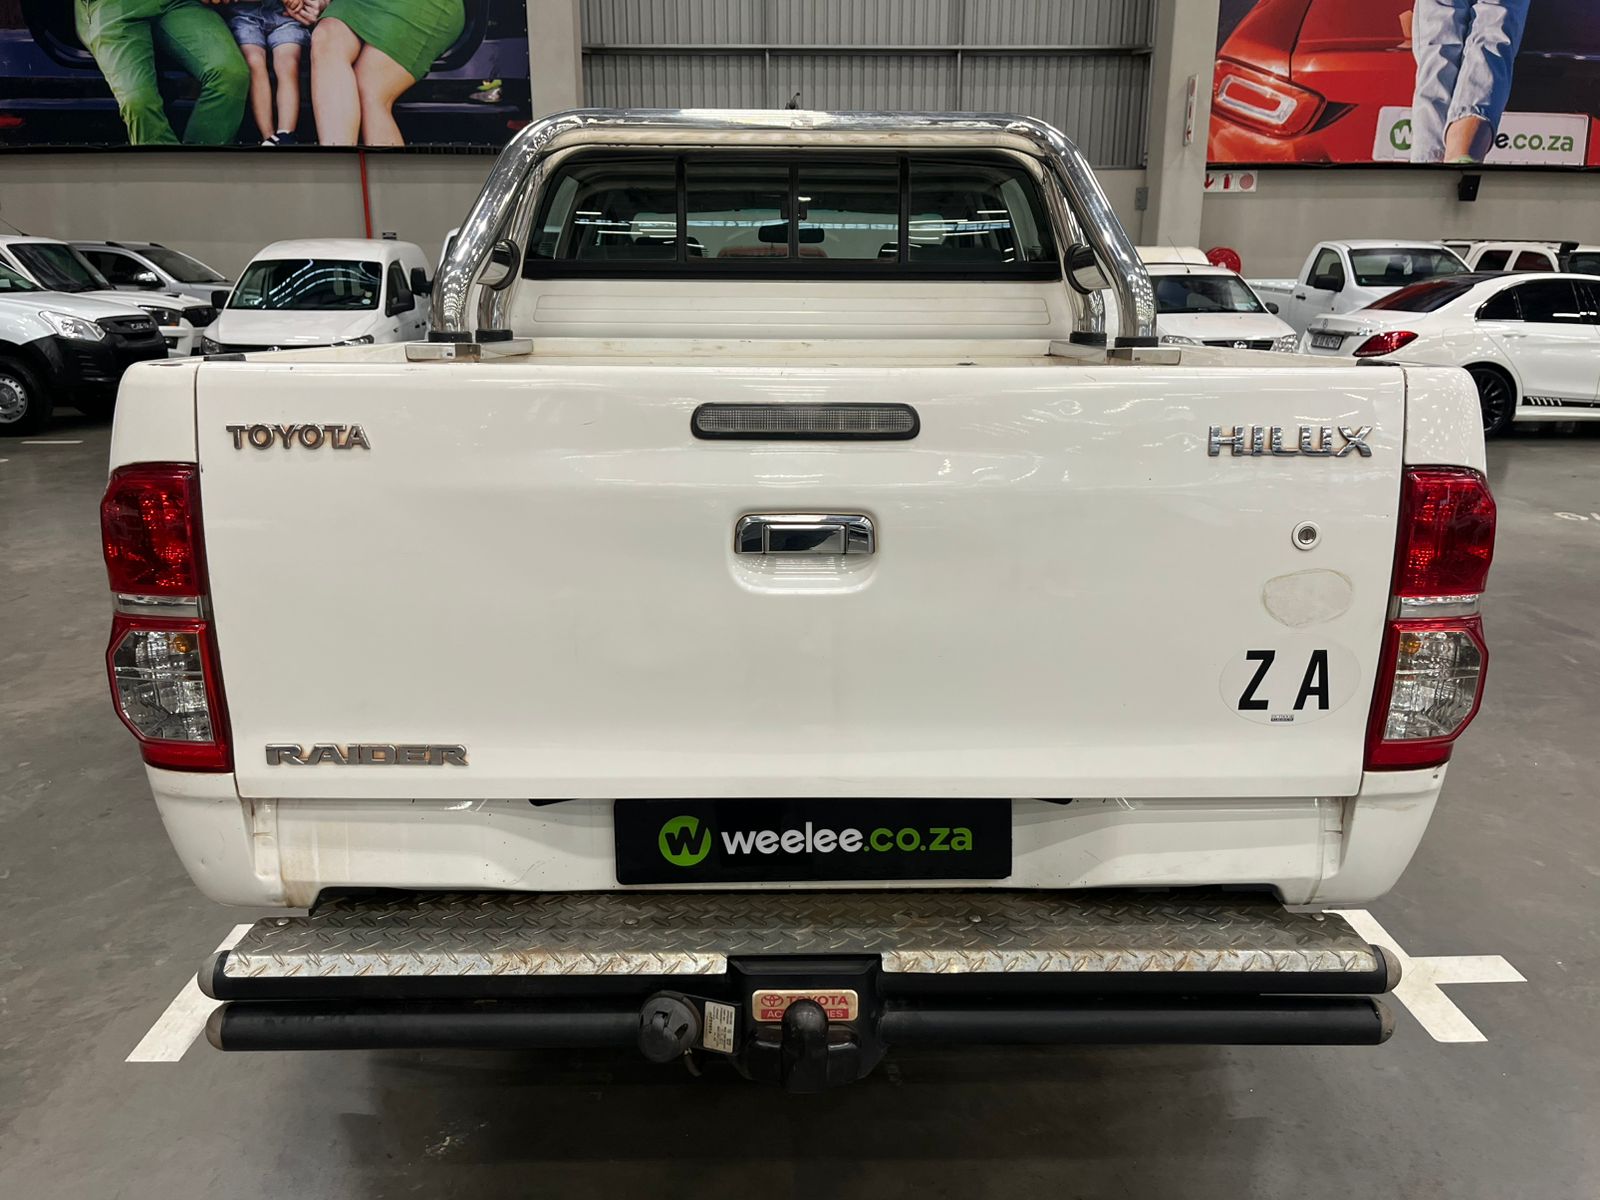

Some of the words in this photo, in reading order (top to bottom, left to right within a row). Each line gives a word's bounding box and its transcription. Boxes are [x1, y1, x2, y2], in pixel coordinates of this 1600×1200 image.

[1495, 132, 1574, 152] e.co.za
[226, 424, 371, 450] TOYOTA
[1208, 425, 1372, 457] HILUX
[265, 743, 469, 766] RAIDER
[720, 821, 973, 854] weelee.co.za
[787, 995, 848, 1006] TYOTA
